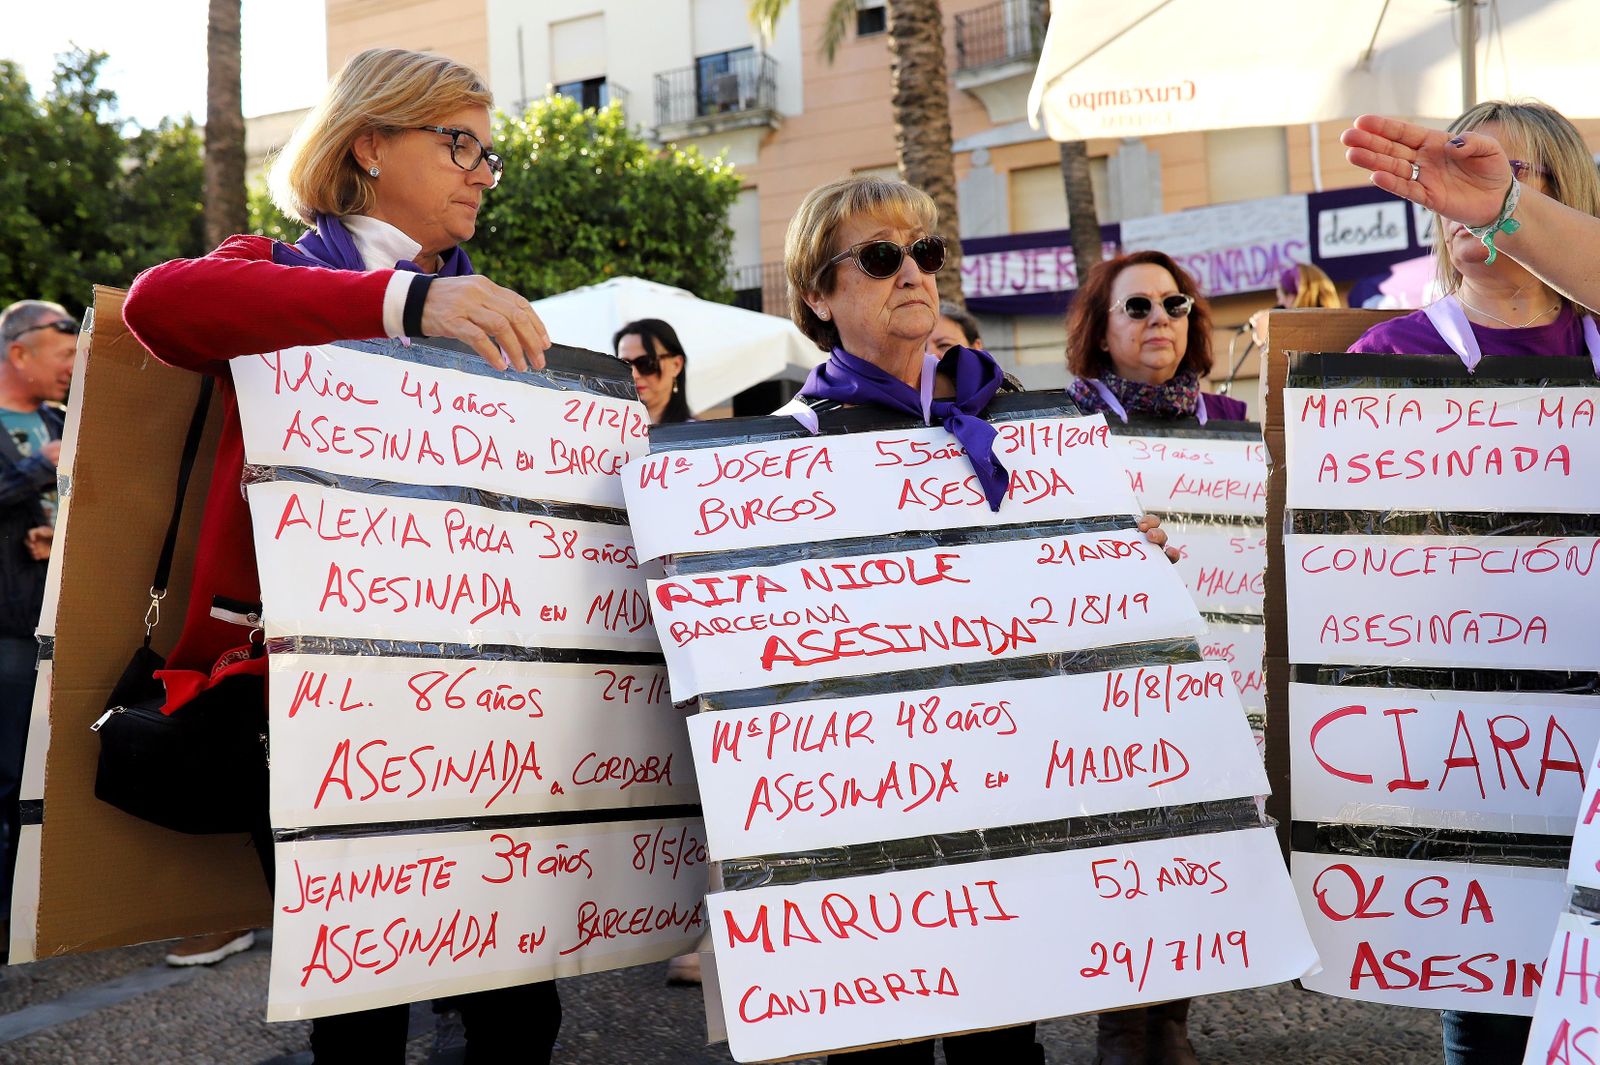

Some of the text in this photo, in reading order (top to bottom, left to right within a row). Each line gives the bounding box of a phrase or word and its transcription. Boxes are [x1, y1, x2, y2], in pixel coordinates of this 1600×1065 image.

[1324, 209, 1399, 245] desde
[961, 246, 1078, 296] MUJER
[283, 409, 502, 472] ASESINADA
[544, 439, 629, 476] BARCE
[452, 393, 515, 423] años
[564, 399, 649, 445] 2/12/20
[1301, 393, 1595, 432] MARÍA DEL MA
[698, 446, 832, 487] JOSEFA
[932, 443, 968, 460] año
[998, 422, 1110, 455] 31/7/2019
[1318, 444, 1570, 484] ASESINADA
[275, 492, 431, 549] ALEXIA
[444, 507, 512, 554] PAOLA
[694, 491, 836, 536] BURGOS
[897, 467, 1076, 512] ASESADA
[656, 574, 788, 612] RITA
[800, 554, 970, 592] NICOLE
[1037, 540, 1075, 565] 21
[1197, 569, 1264, 594] MALAG
[1302, 538, 1600, 576] CONCEPCIÓN
[319, 562, 652, 632] ASESINADA EN MAD
[1321, 610, 1546, 647] ASESINADA
[669, 602, 851, 648] BARCELONA
[760, 616, 1038, 672] ASESINADA
[407, 666, 478, 712] 86
[476, 684, 544, 719] años
[897, 695, 941, 738] 48
[946, 701, 1017, 735] años
[1102, 664, 1227, 718] 16/8/2019
[313, 737, 545, 810] ASESINADA
[1310, 705, 1585, 797] CIARA
[745, 738, 1190, 832] ASESINADA EN MADRID
[281, 826, 707, 914] JEANNETE 39 años 8/5/20
[1313, 863, 1493, 924] OLGA
[723, 857, 1228, 953] MARUCHI 52 AÑOS
[300, 900, 700, 989] ASESINADA EN BARCELONA
[739, 930, 1248, 1024] CANTABRIA 29/7/19
[1350, 941, 1546, 997] ASESIN
